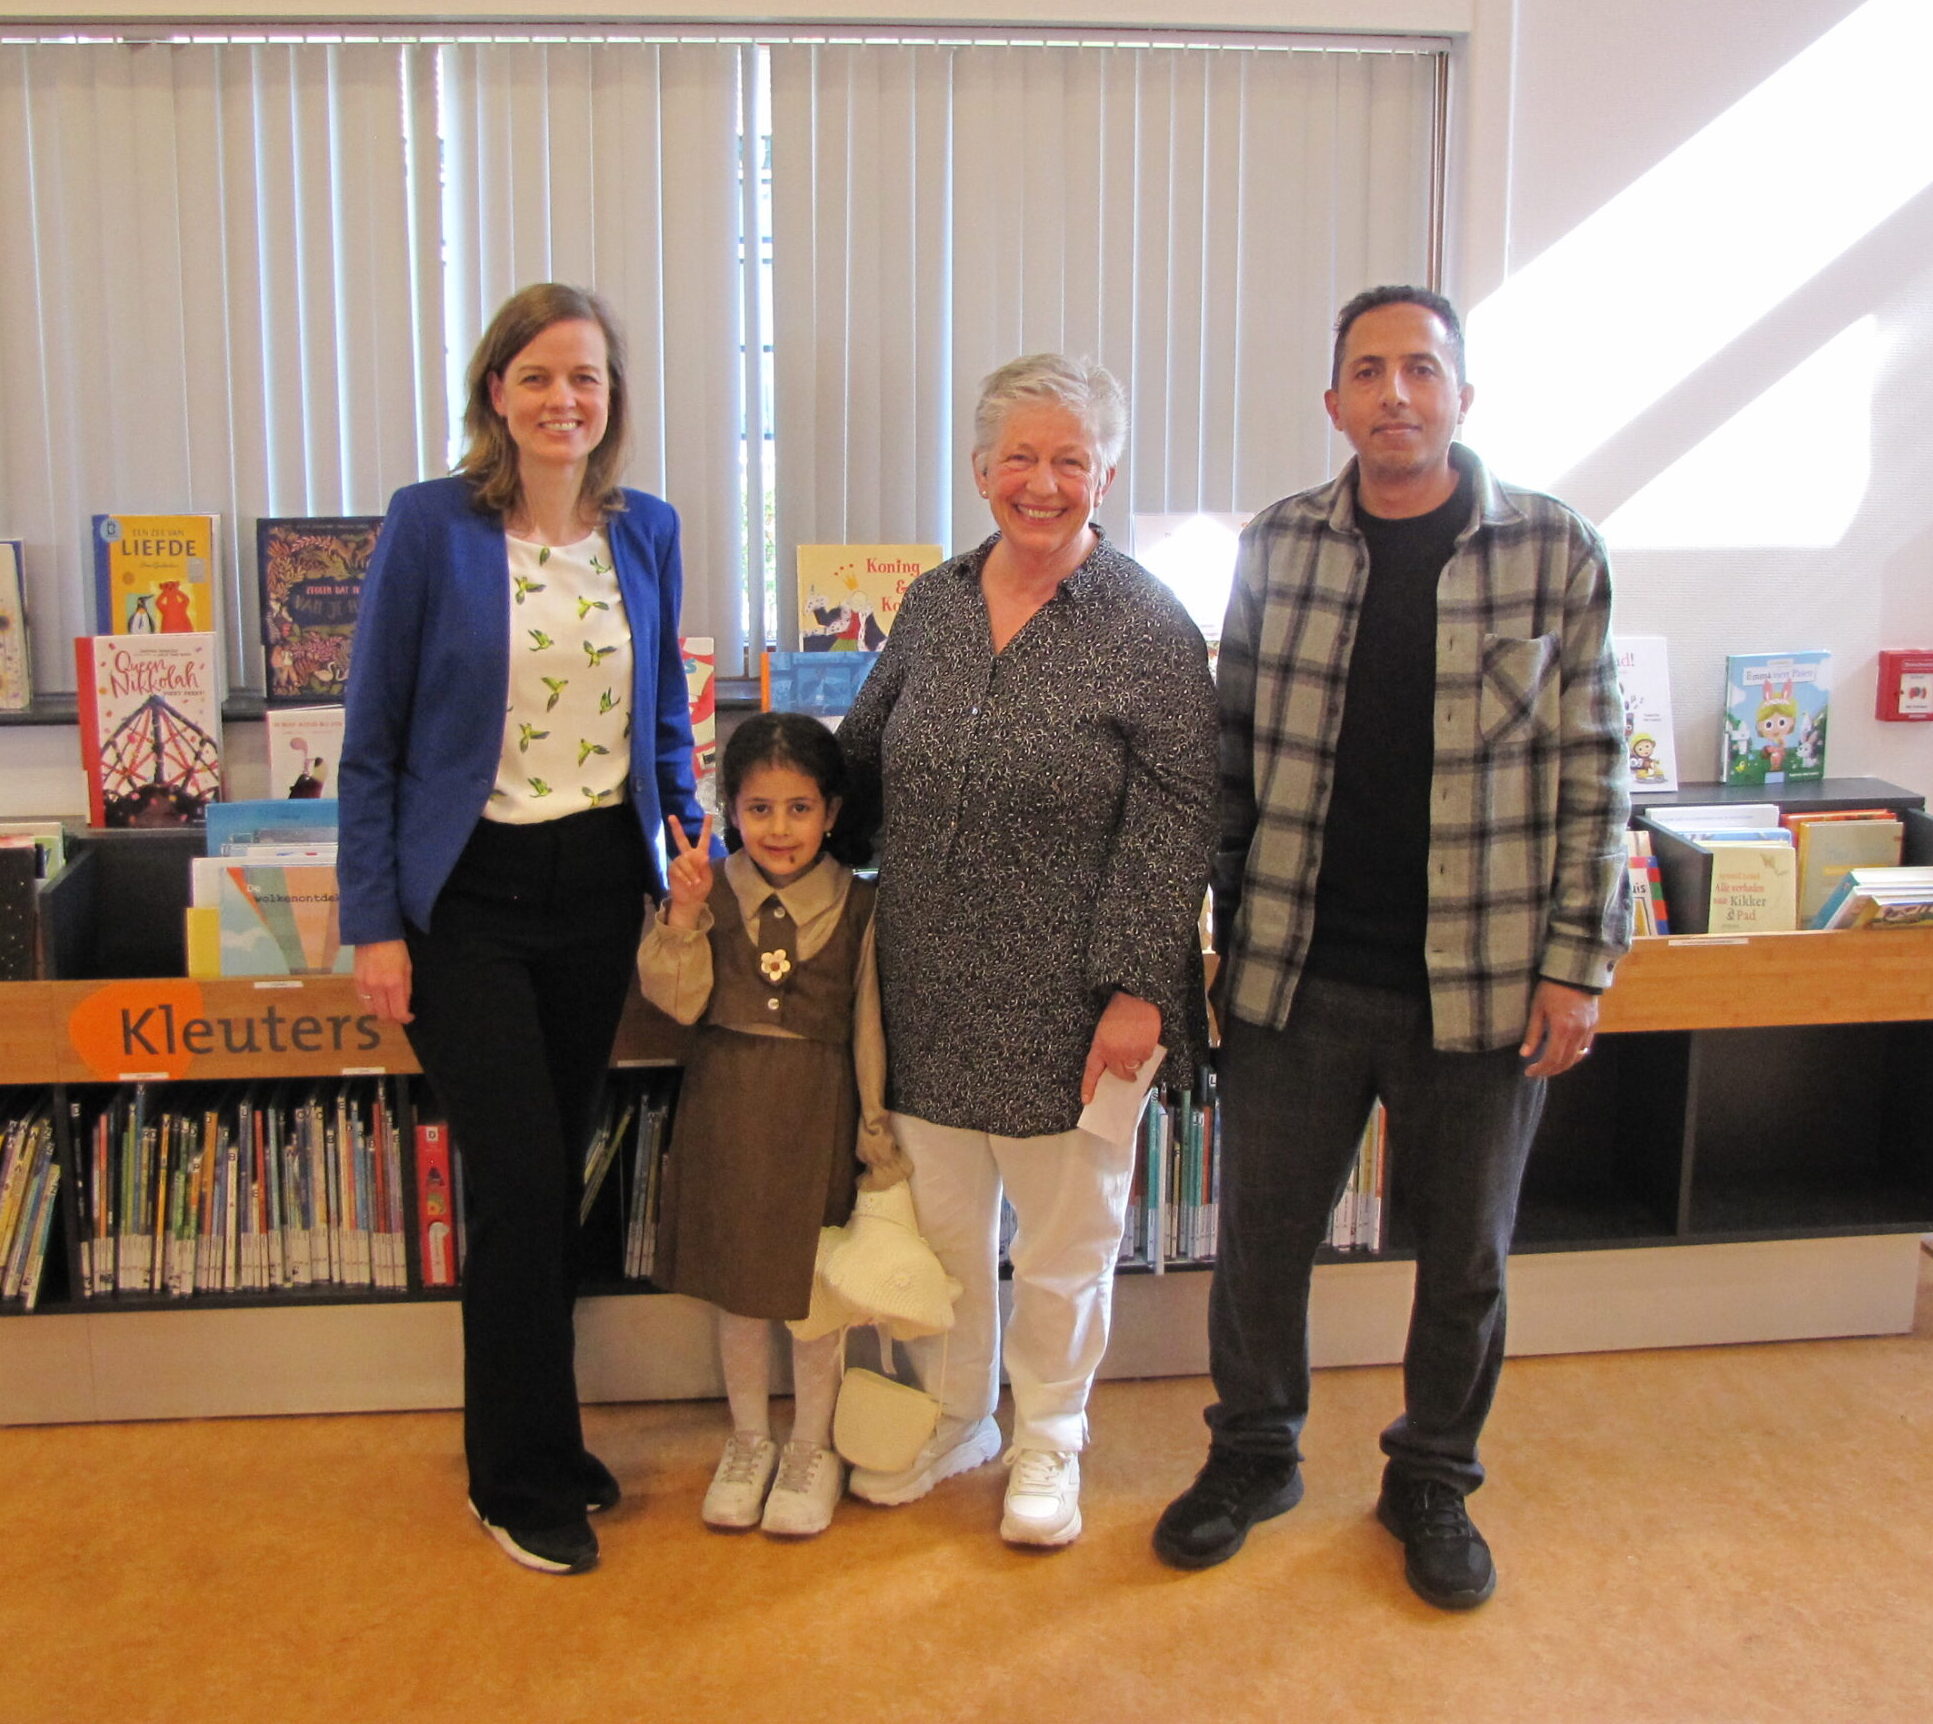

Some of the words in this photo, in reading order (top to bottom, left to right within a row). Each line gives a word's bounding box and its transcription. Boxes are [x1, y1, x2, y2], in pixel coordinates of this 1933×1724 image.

[122, 539, 197, 557] LIEFDE
[866, 558, 920, 577] Koning
[881, 597, 902, 612] Ko
[115, 650, 166, 674] Queen
[110, 661, 200, 698] Nikkolah
[1746, 671, 1771, 681] Emma
[1730, 895, 1767, 907] Kikker
[1737, 910, 1756, 920] Pad
[120, 1003, 381, 1055] Kleuters
